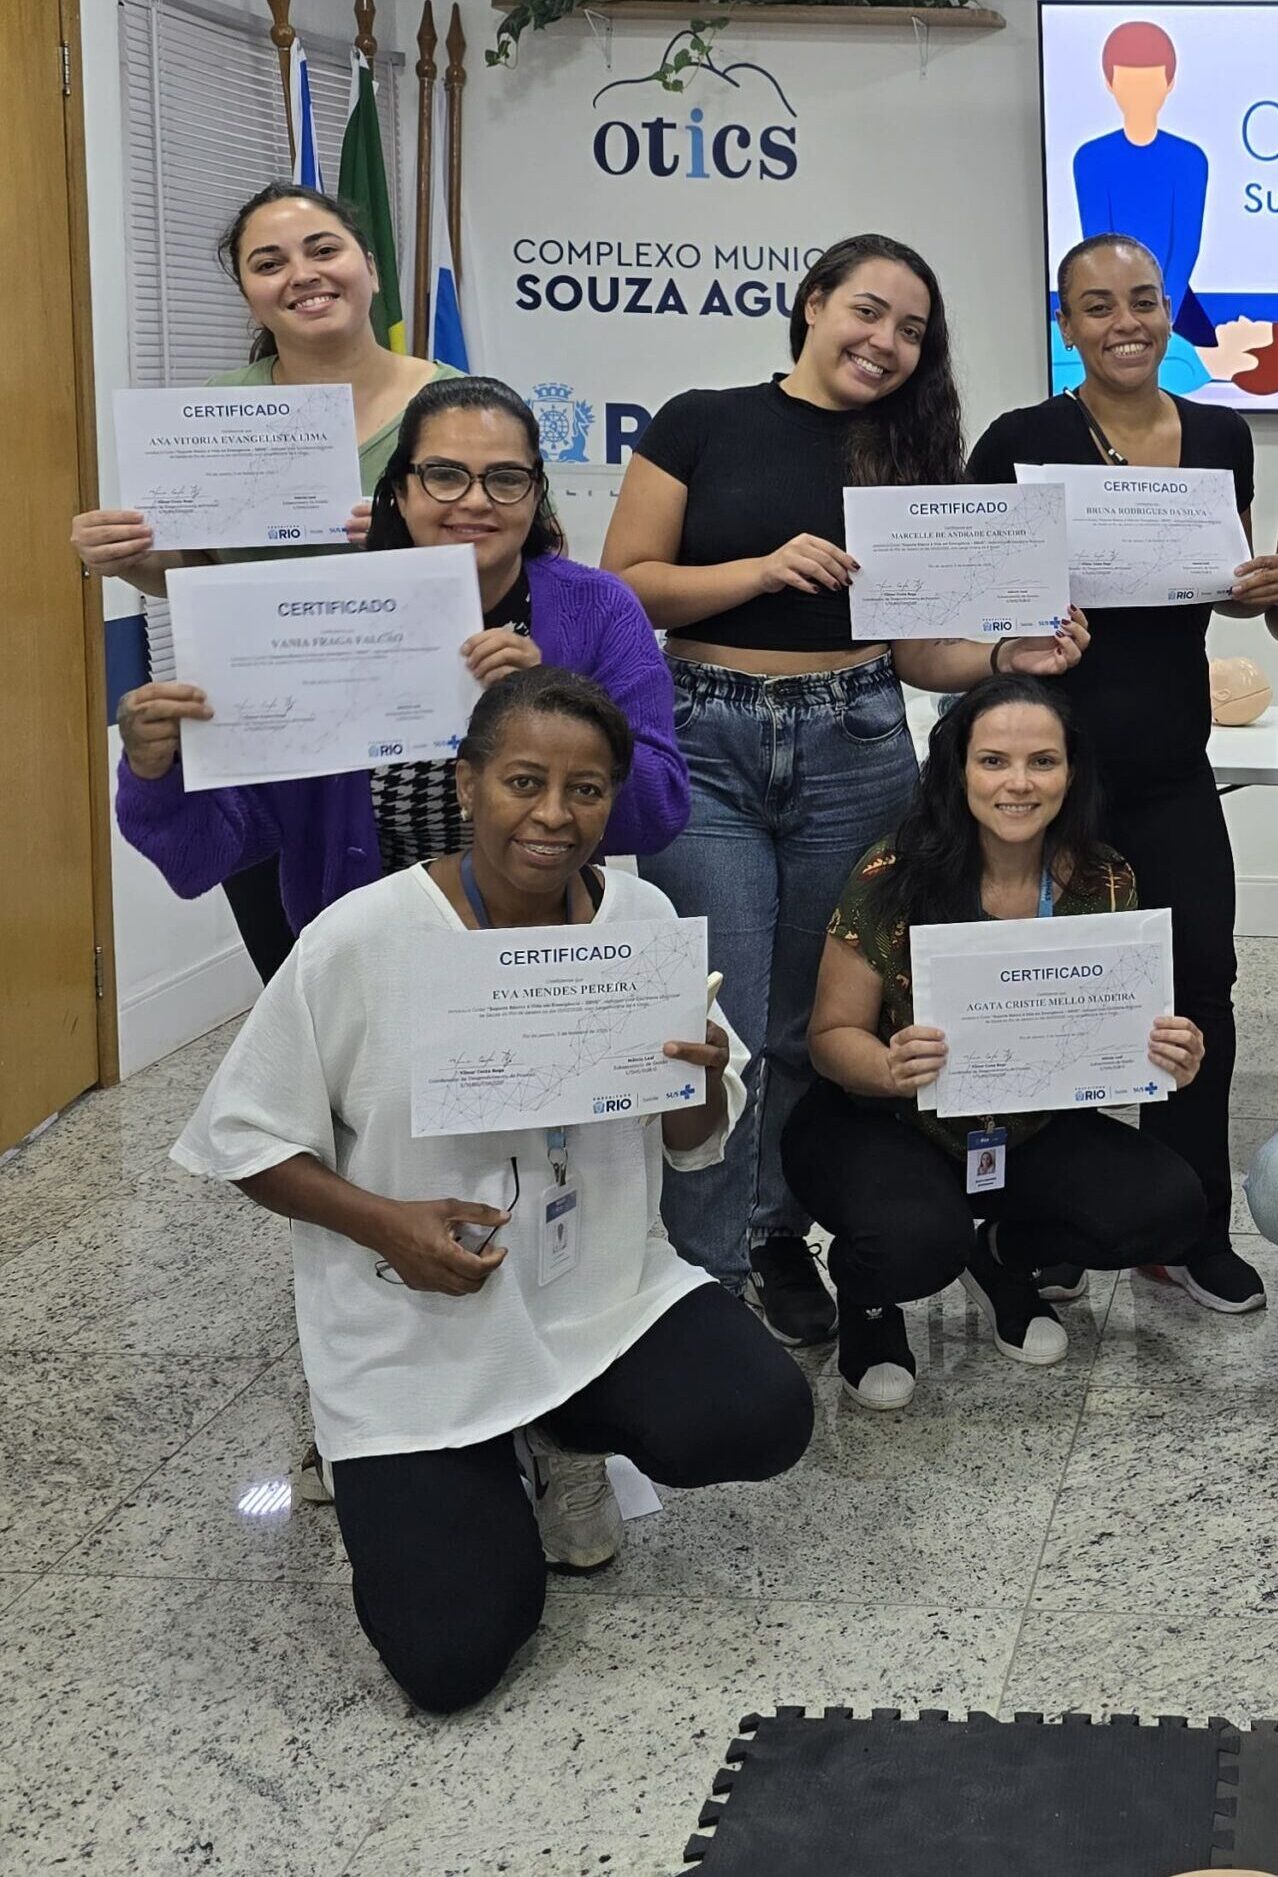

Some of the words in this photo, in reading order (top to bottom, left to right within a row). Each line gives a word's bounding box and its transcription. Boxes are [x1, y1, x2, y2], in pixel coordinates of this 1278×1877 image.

[593, 107, 797, 181] otics
[513, 239, 701, 269] COMPLEXO
[715, 245, 825, 272] MUNIC
[515, 273, 688, 315] SOUZA
[699, 279, 792, 318] AGU
[183, 403, 290, 418] CERTIFICADO
[149, 437, 171, 446] ANA
[174, 436, 218, 445] VITORIA
[221, 433, 296, 444] EVANGELISTA
[299, 433, 328, 442] LIMA
[1104, 481, 1188, 494] CERTIFICADO
[909, 501, 1008, 515] CERTIFICADO
[1118, 507, 1168, 516] RODRIGUES
[1169, 508, 1182, 516] DA
[1184, 508, 1207, 517] SILVA
[279, 529, 301, 539] RIO
[891, 532, 935, 540] MARCELLE
[948, 530, 985, 538] ANDRADE
[1176, 591, 1194, 600] RIO
[278, 598, 397, 617] CERTIFICADO
[992, 621, 1012, 631] RIO
[380, 744, 403, 757] RIO
[499, 944, 632, 966] CERTIFICADO
[1000, 964, 1103, 983] CERTIFICADO
[492, 990, 519, 1000] EVA
[522, 986, 577, 999] MENDES
[580, 981, 637, 995] PEREIRA
[966, 1002, 1003, 1012] AGATA
[1005, 999, 1046, 1009] CRISTIE
[1048, 995, 1085, 1006] MELLO
[1088, 992, 1136, 1004] MADEIRA
[1085, 1089, 1106, 1101] RIO
[606, 1098, 632, 1112] RIO
